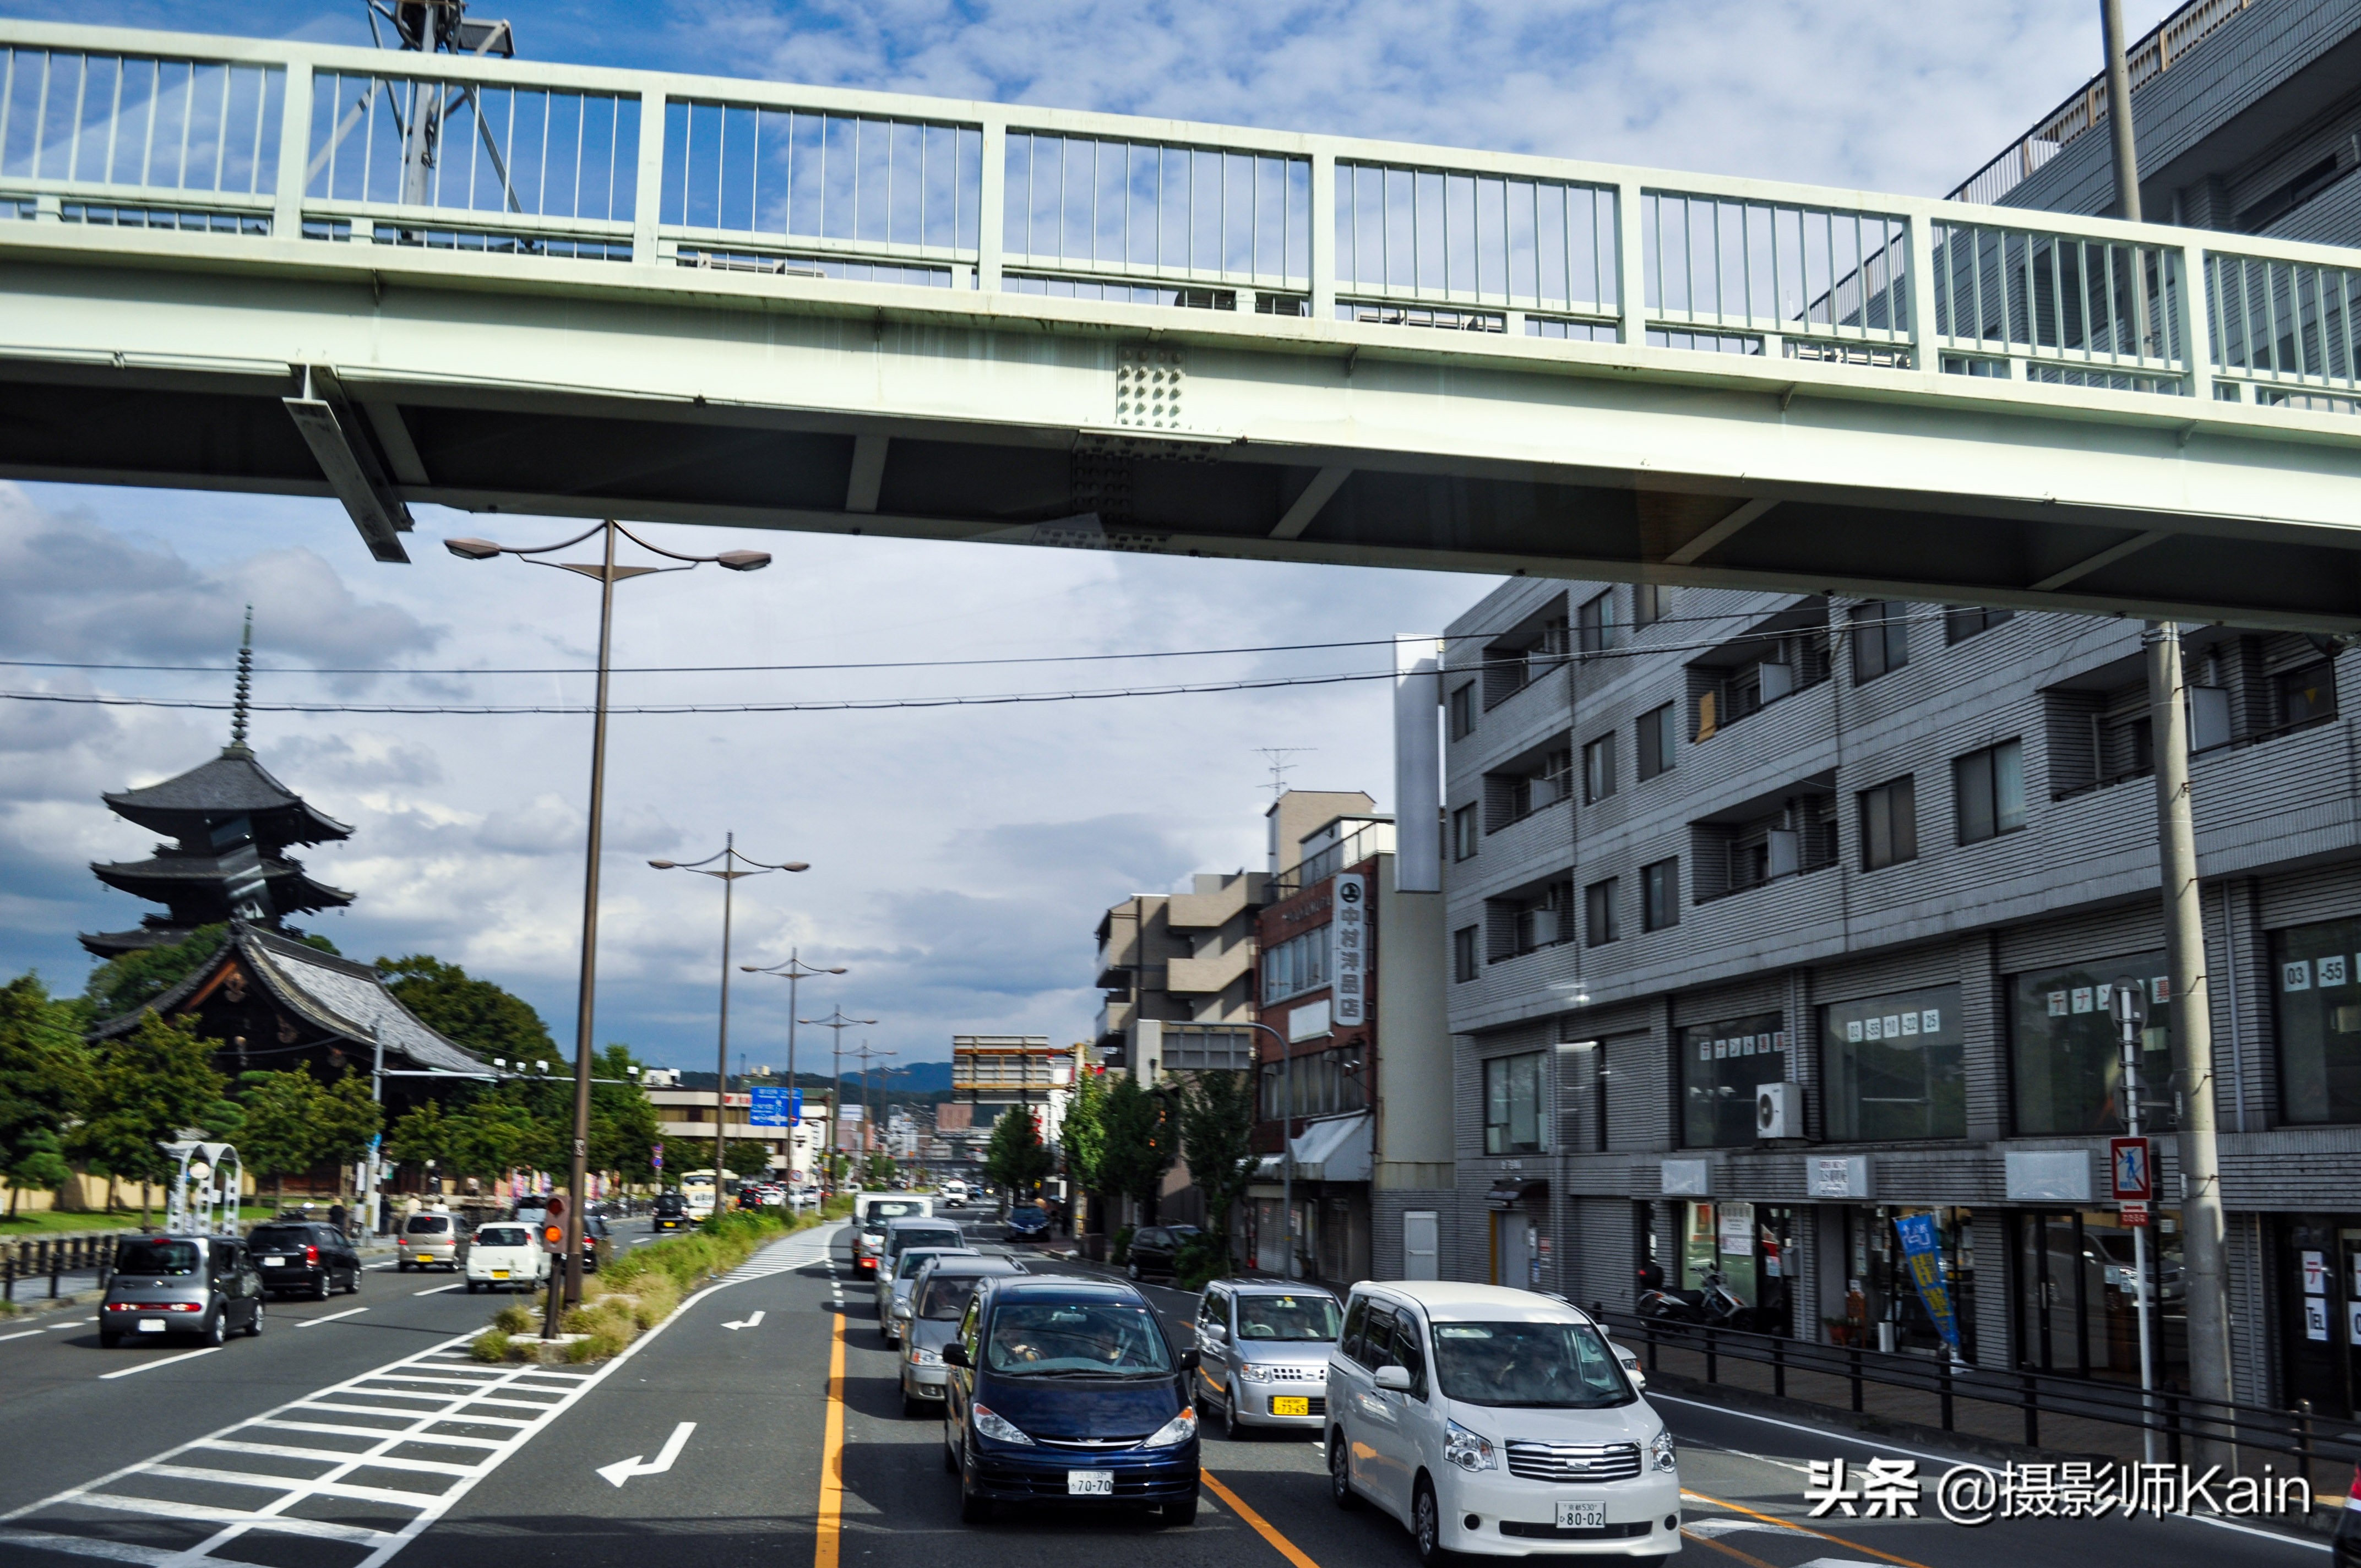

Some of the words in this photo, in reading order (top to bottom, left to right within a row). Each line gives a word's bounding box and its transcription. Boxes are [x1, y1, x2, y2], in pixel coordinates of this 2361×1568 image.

[2306, 1306, 2325, 1330] TEL
[1078, 1480, 1111, 1492] 70-70
[1567, 1512, 1602, 1526] 80-02
